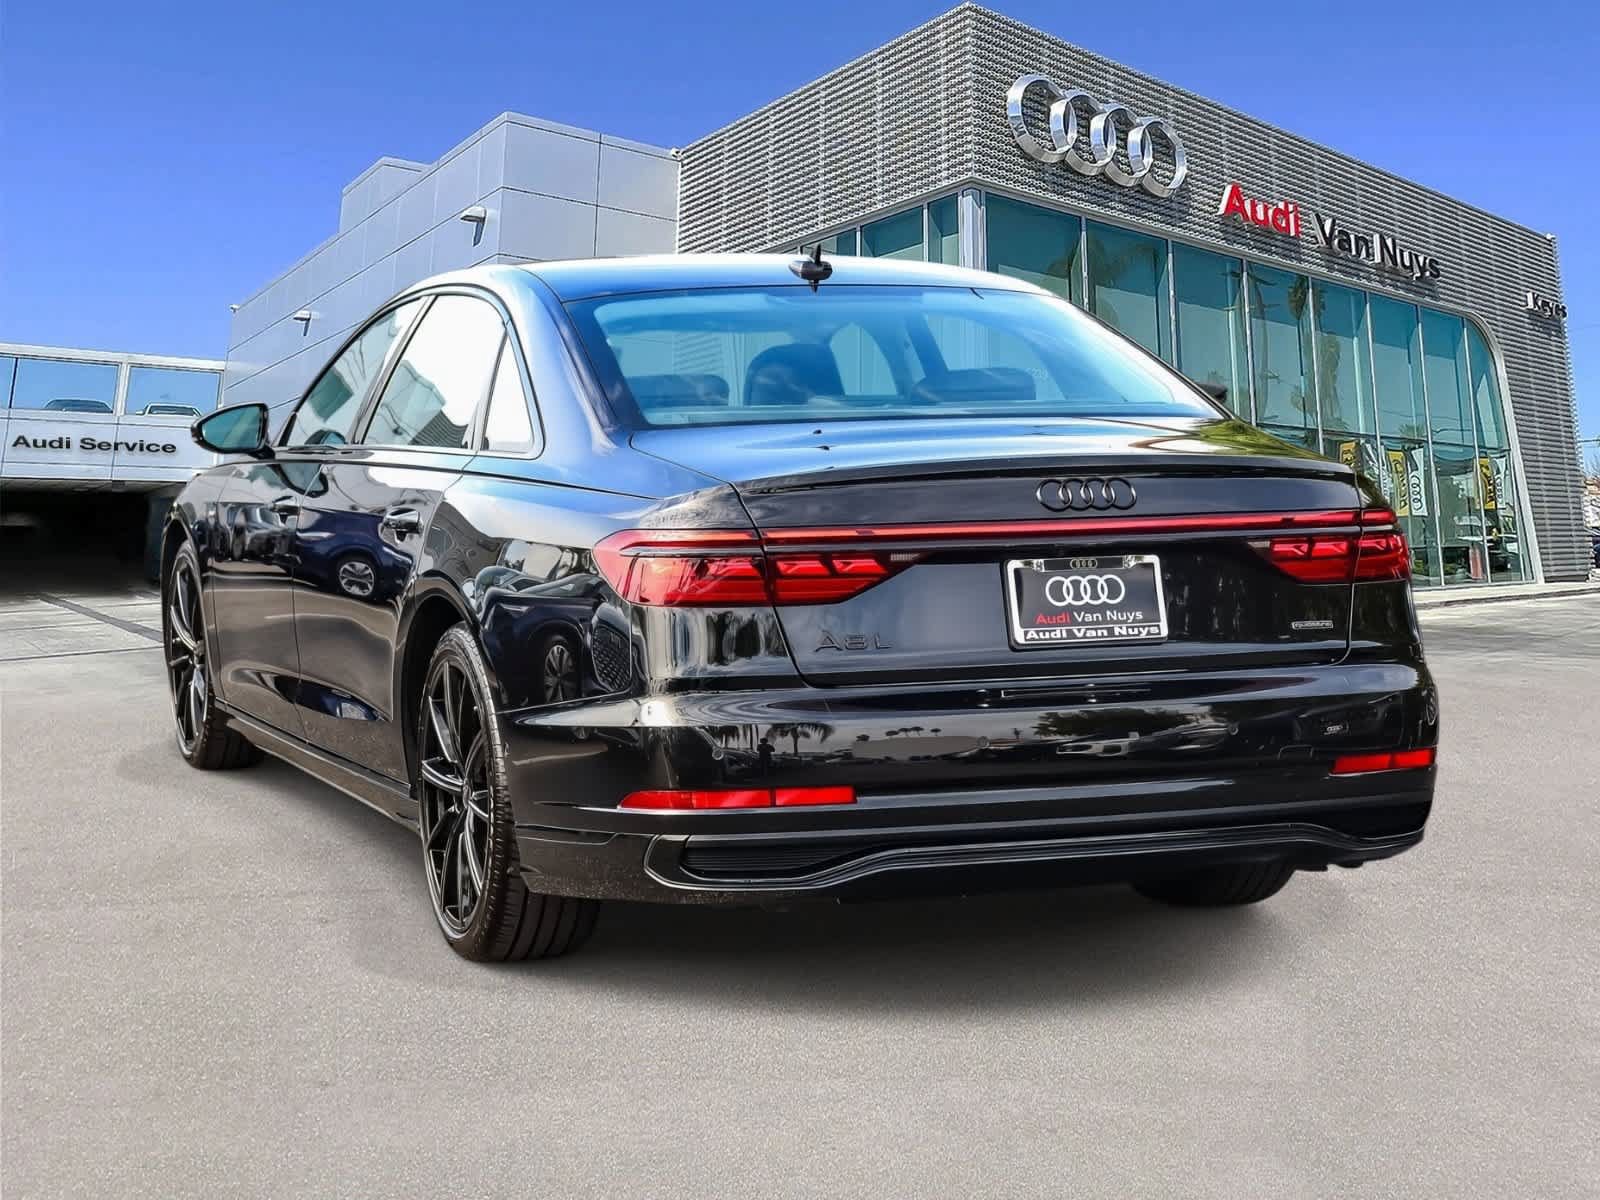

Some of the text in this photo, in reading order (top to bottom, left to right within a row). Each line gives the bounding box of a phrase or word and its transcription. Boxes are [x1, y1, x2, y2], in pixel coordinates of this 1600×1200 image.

[1217, 181, 1442, 281] Audi Van Nuys
[12, 434, 177, 454] Audi Service
[1035, 610, 1144, 625] Audi Van Nuys
[1025, 625, 1160, 640] Audi Van Nuys
